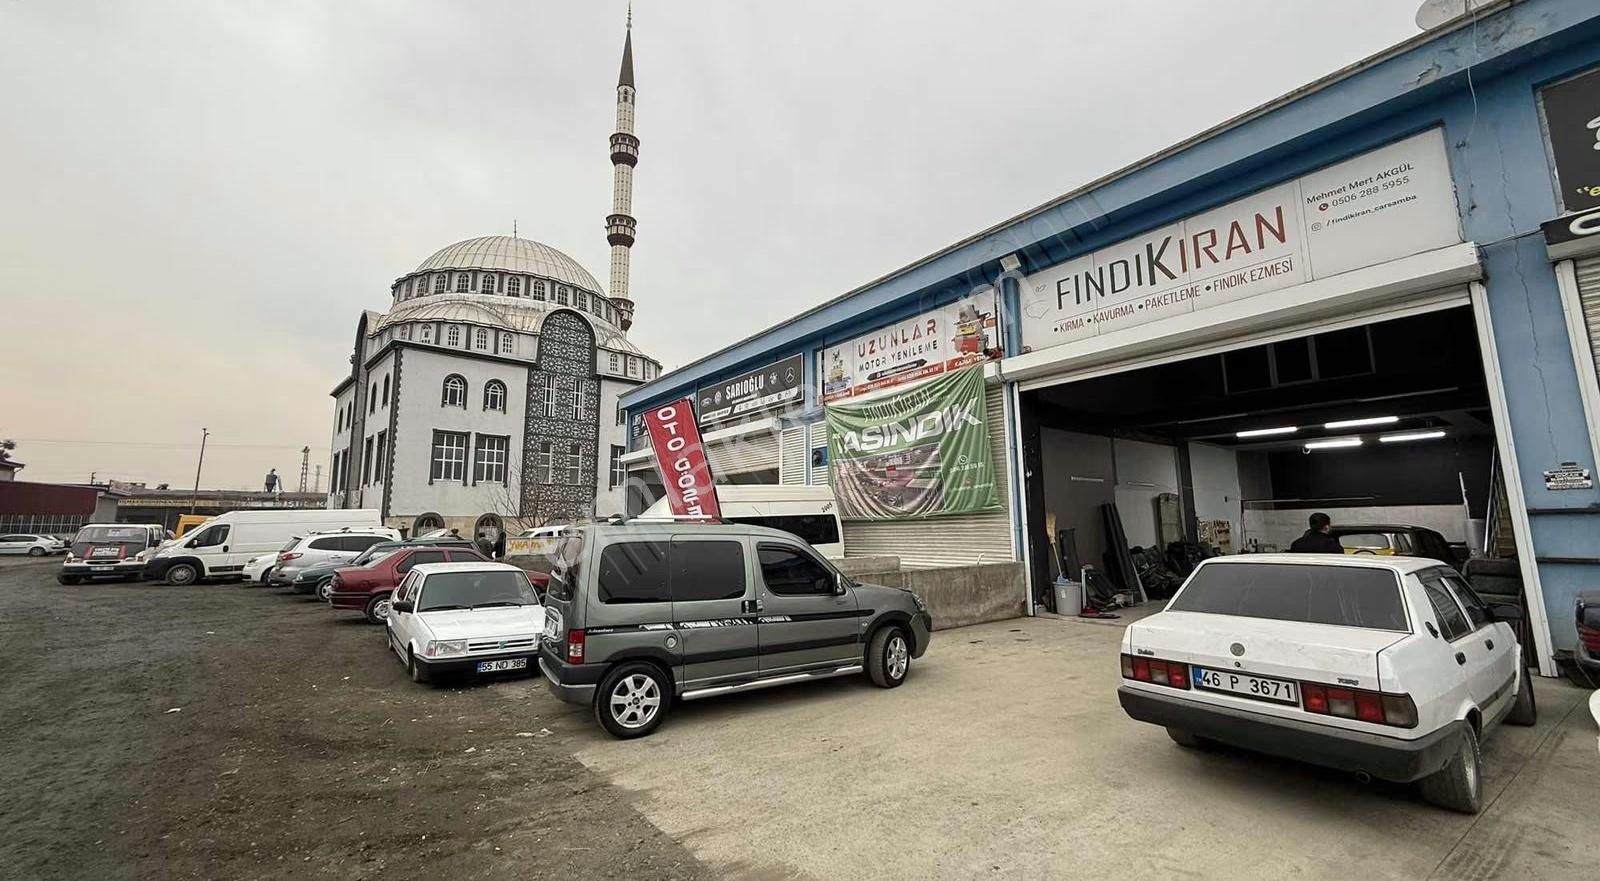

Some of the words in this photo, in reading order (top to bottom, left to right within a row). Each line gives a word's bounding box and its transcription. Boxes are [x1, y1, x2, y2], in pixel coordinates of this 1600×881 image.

[1306, 186, 1346, 204] Mehmet
[1348, 177, 1373, 191] Mert
[1376, 161, 1414, 181] AKGÜL
[1332, 193, 1357, 207] 0506
[1359, 185, 1379, 198] 288
[1382, 175, 1410, 191] 5955
[1056, 206, 1287, 310] FINDIKIRAN
[1059, 319, 1085, 333] KIRMA
[1093, 304, 1135, 324] KAVURMA
[1144, 284, 1202, 310] PAKETLEME
[1213, 272, 1249, 292] FINDIK
[1250, 257, 1294, 282] EZMESİ
[857, 318, 937, 358] UZUNLAR
[858, 356, 887, 373] MOTOR
[890, 340, 939, 363] YENİLEME
[725, 373, 764, 401] SARIOĞLU
[656, 405, 686, 452] OTO
[482, 662, 493, 671] 55
[495, 661, 508, 670] ND
[511, 659, 526, 668] 385
[1202, 671, 1220, 687] 46
[1230, 677, 1239, 690] P
[1250, 679, 1292, 699] 3671
